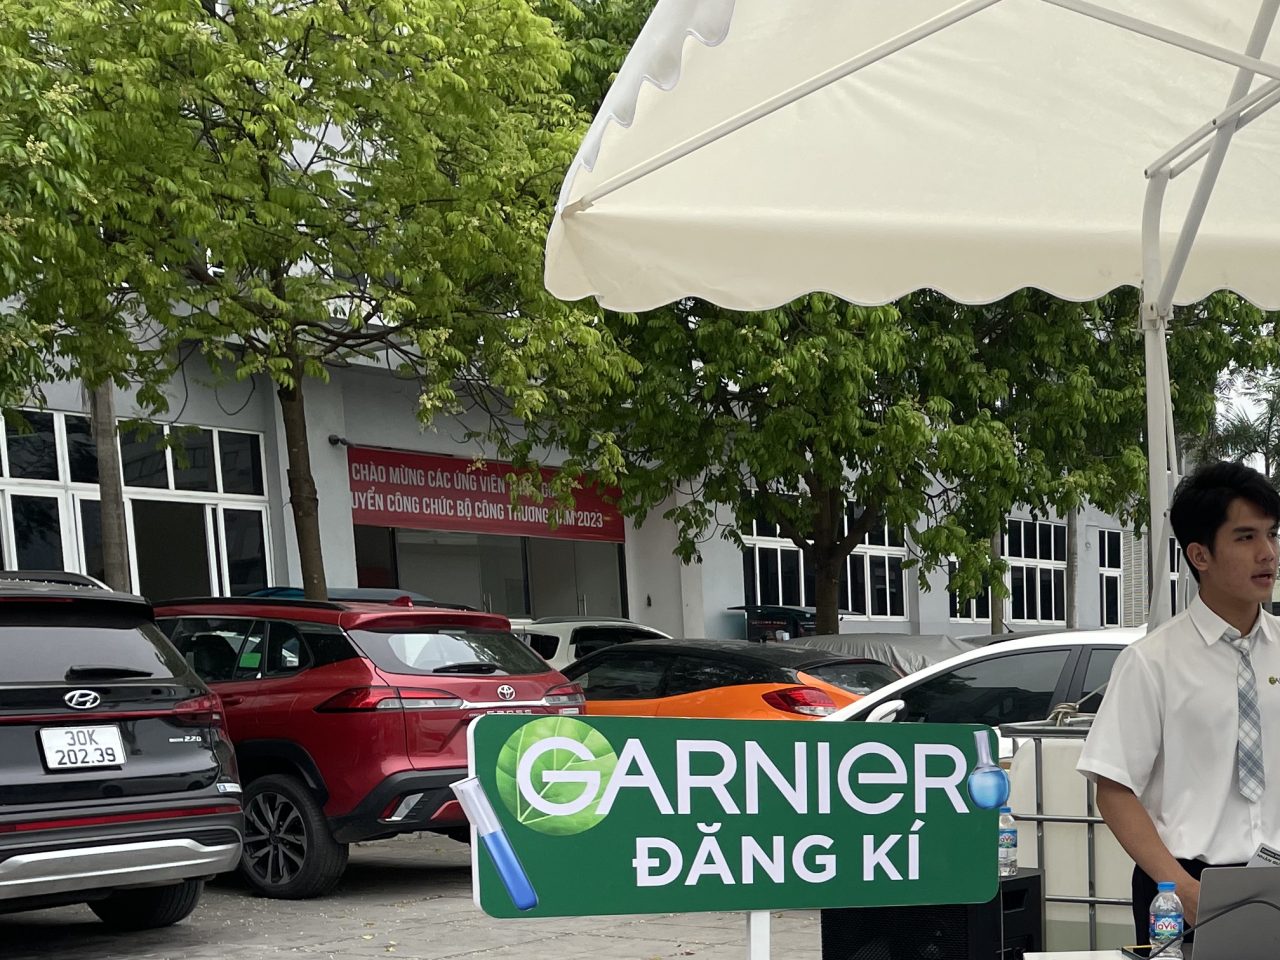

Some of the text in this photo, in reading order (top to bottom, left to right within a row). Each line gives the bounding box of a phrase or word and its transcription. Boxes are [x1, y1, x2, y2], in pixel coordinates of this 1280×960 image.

[352, 462, 385, 483] CHÀO
[389, 465, 424, 486] MỪNG
[428, 468, 451, 489] CÁC
[454, 470, 477, 491] ỨNG
[479, 472, 506, 494] VIÊN
[350, 486, 384, 512] UYỂN
[387, 492, 420, 514] CÔNG
[423, 495, 454, 516] CHỨC
[457, 497, 472, 520] BỘ
[475, 499, 504, 520] CÔNG
[577, 511, 604, 528] 2023
[55, 747, 117, 766] 202.39
[64, 729, 99, 747] 30K
[517, 736, 971, 816] GARNIER
[632, 819, 926, 887] ĐĂNG KÍ
